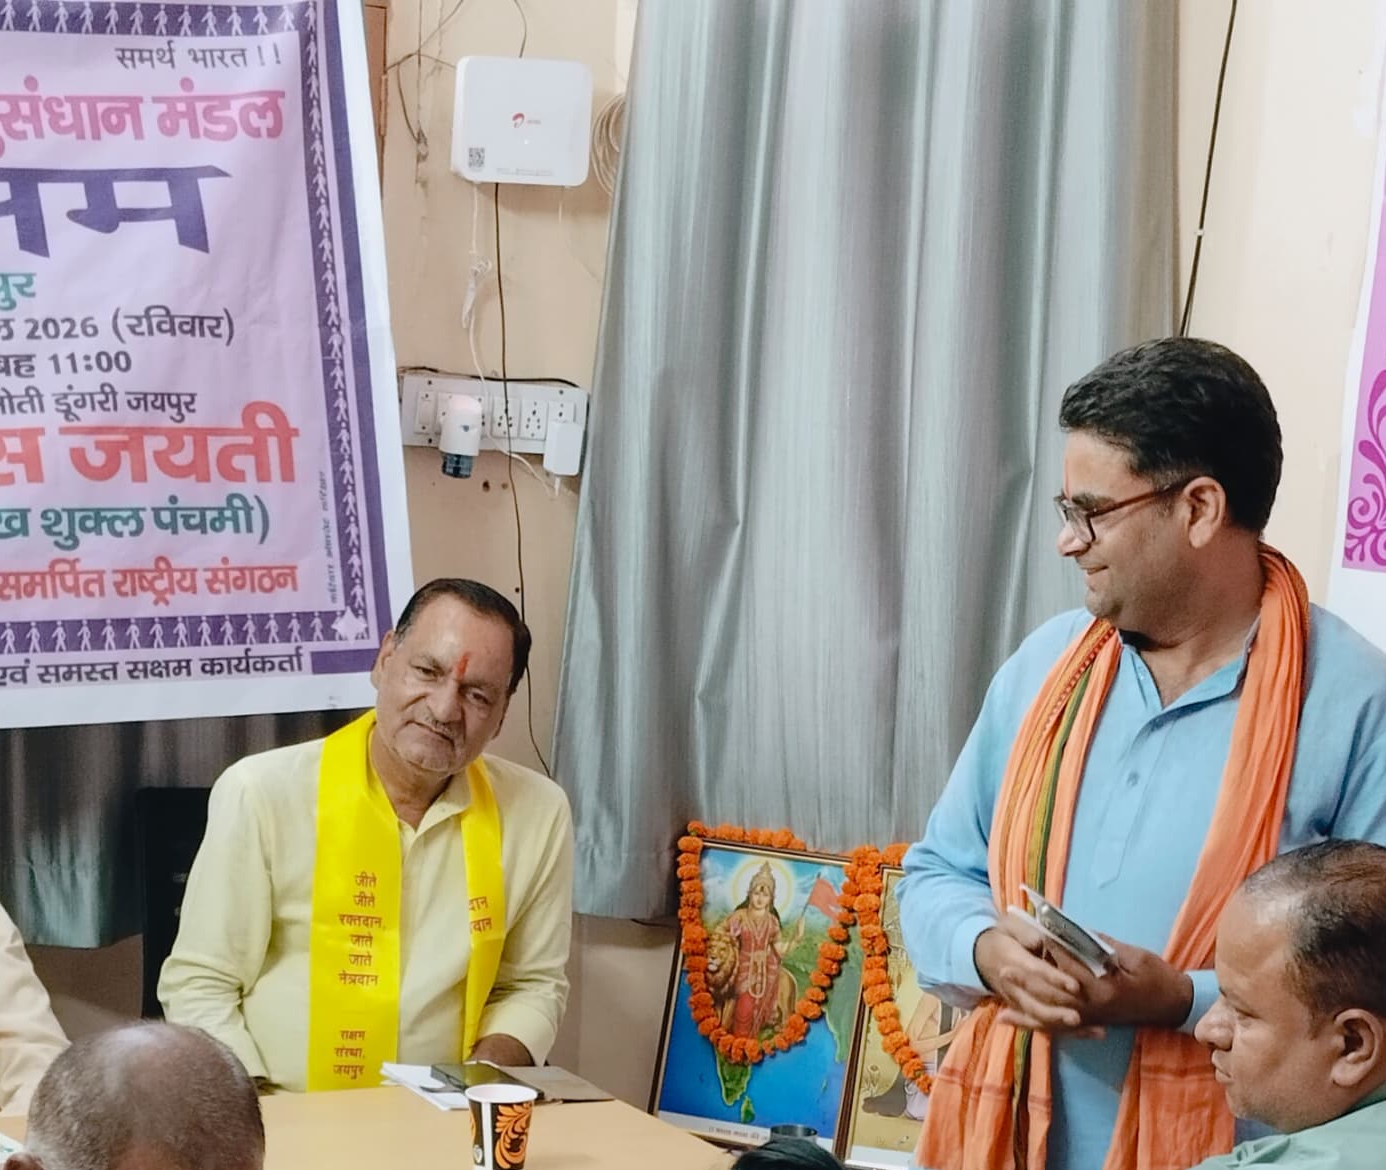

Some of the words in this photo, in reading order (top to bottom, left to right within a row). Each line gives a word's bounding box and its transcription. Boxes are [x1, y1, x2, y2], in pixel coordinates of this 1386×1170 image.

[115, 42, 175, 70] समर्थ
[189, 46, 248, 69] भारत
[152, 77, 286, 140] मंडल
[25, 317, 100, 340] 2026
[111, 306, 236, 346] (रविवार)
[49, 351, 132, 375] 11:00
[53, 383, 119, 422] डूंगरी
[126, 390, 197, 424] जयपुर
[40, 500, 145, 553] शुक्ल
[151, 493, 271, 546] पंचमी)
[112, 555, 199, 608] राष्ट्रीय
[203, 556, 299, 597] संगठन
[37, 661, 119, 685] समस्त
[125, 655, 193, 680] सक्षम
[199, 645, 304, 678] कार्यकर्ता
